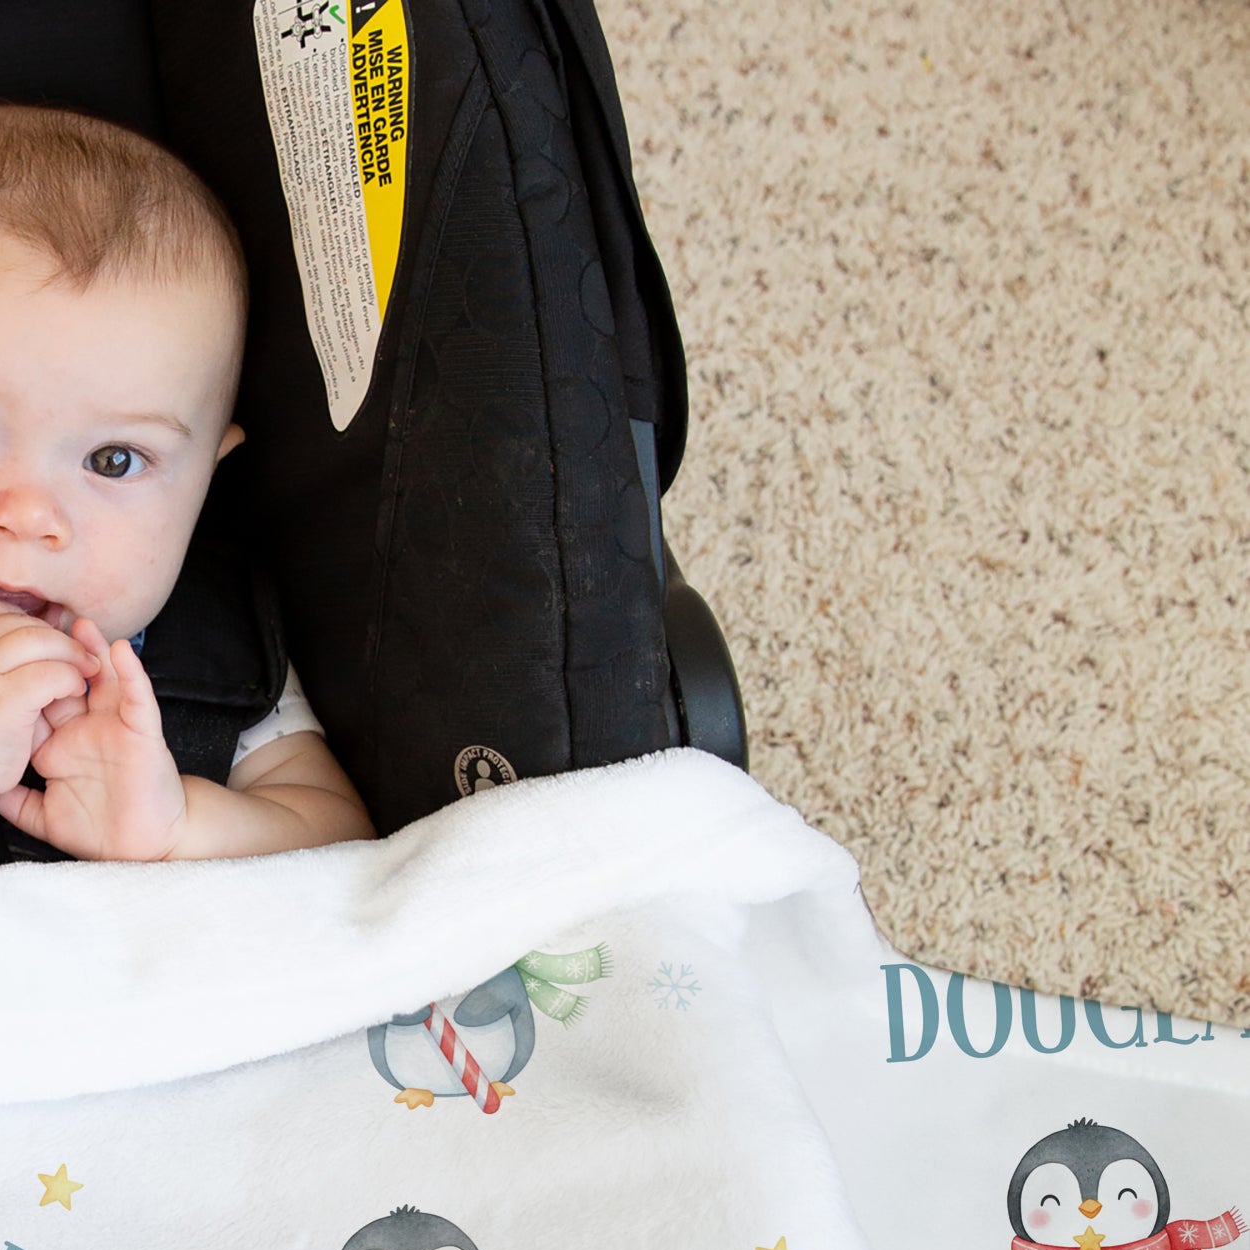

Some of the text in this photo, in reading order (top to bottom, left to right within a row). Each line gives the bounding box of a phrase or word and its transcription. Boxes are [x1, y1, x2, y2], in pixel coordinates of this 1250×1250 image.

[352, 43, 376, 185] ADVERTENCIA
[368, 29, 392, 188] MISE EN GARDE
[387, 44, 405, 142] WARNING
[345, 122, 361, 199] STRANGLED
[357, 214, 366, 245] loose
